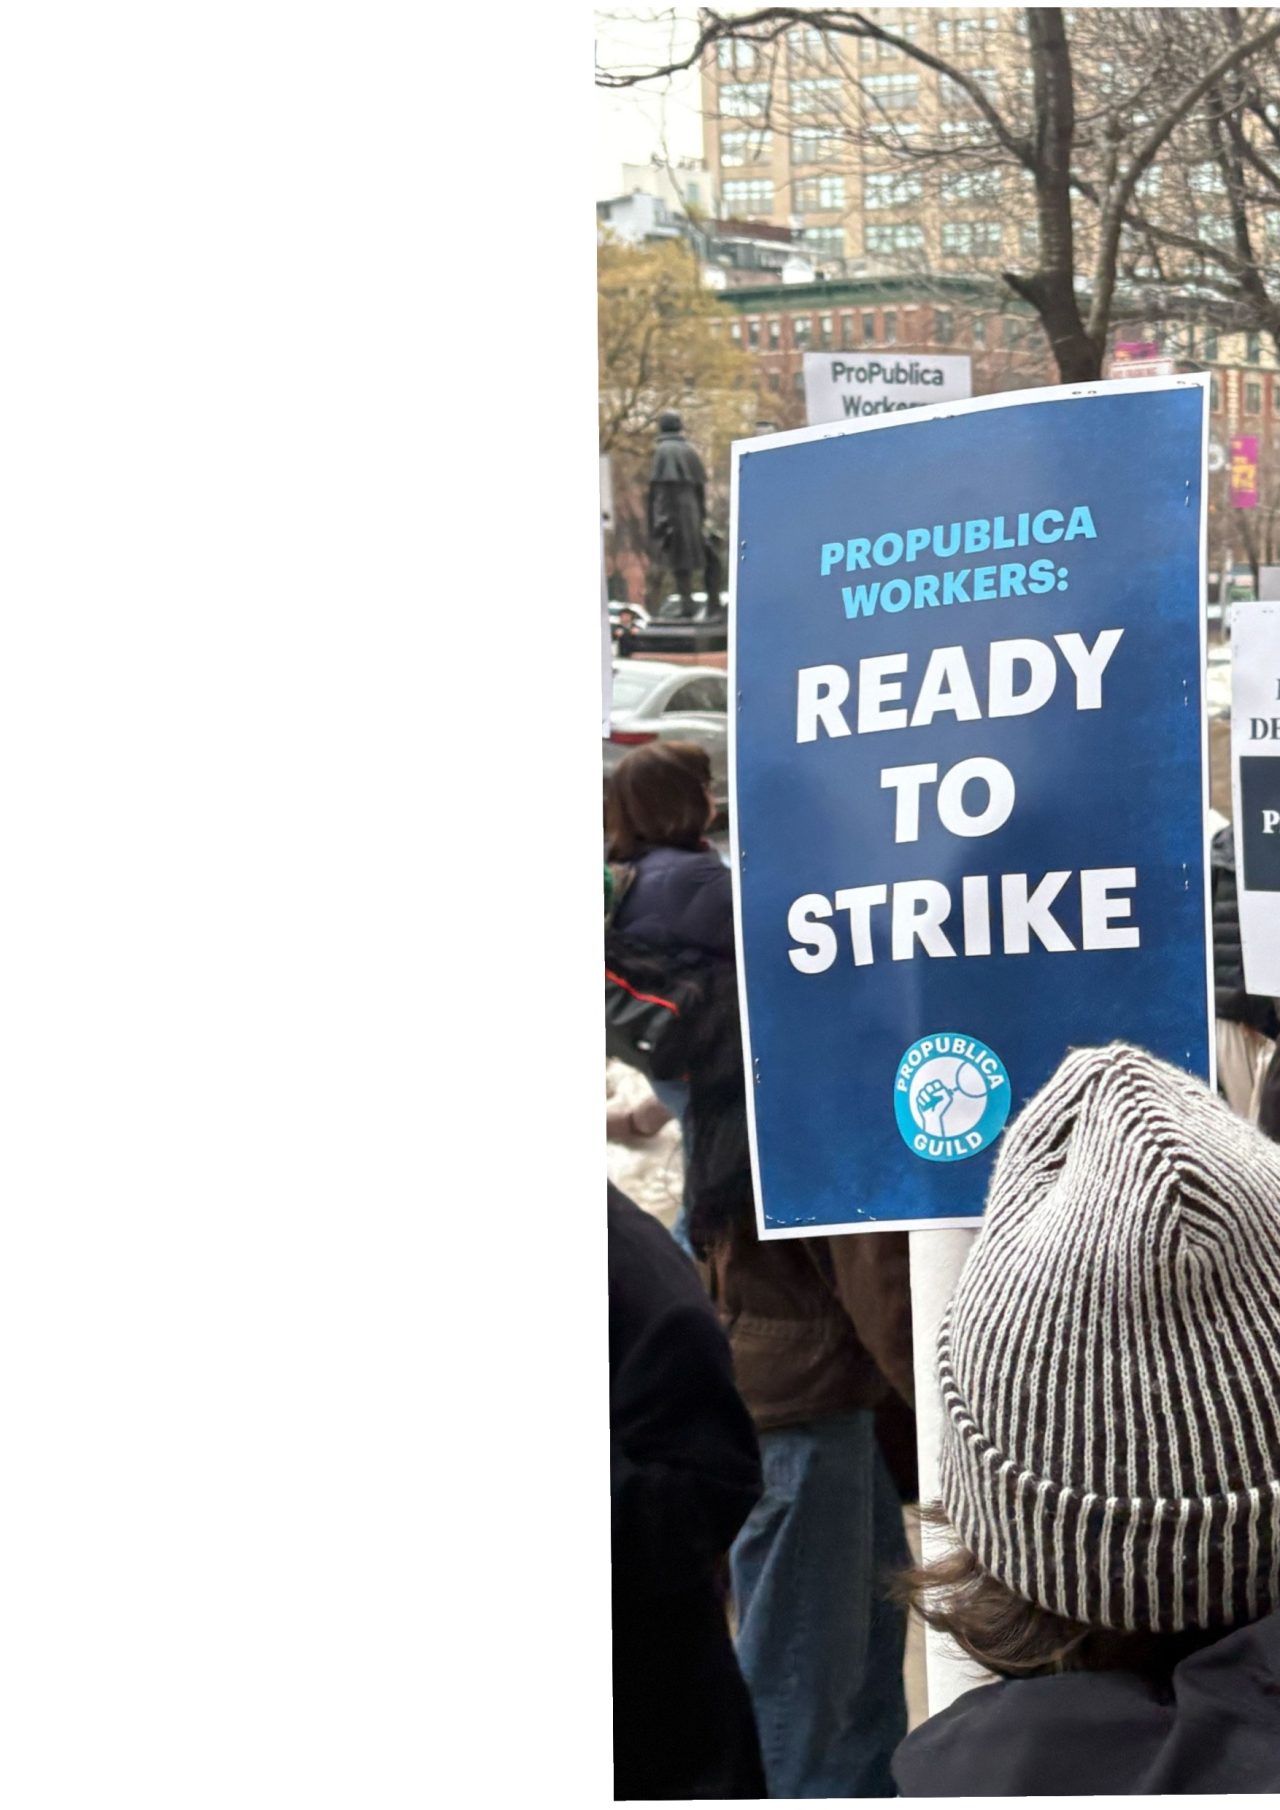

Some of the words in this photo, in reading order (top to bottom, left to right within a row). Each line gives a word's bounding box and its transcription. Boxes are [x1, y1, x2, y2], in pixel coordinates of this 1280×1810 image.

[831, 361, 944, 386] ProPublica
[821, 506, 1097, 576] PROPUBLICA
[841, 558, 1069, 619] WORKERS:
[796, 628, 1125, 744] READY
[880, 756, 1016, 843] TO
[787, 867, 1140, 974] STRIKE
[897, 1037, 1005, 1093] PROPUBLICA
[913, 1131, 983, 1157] GUILD
